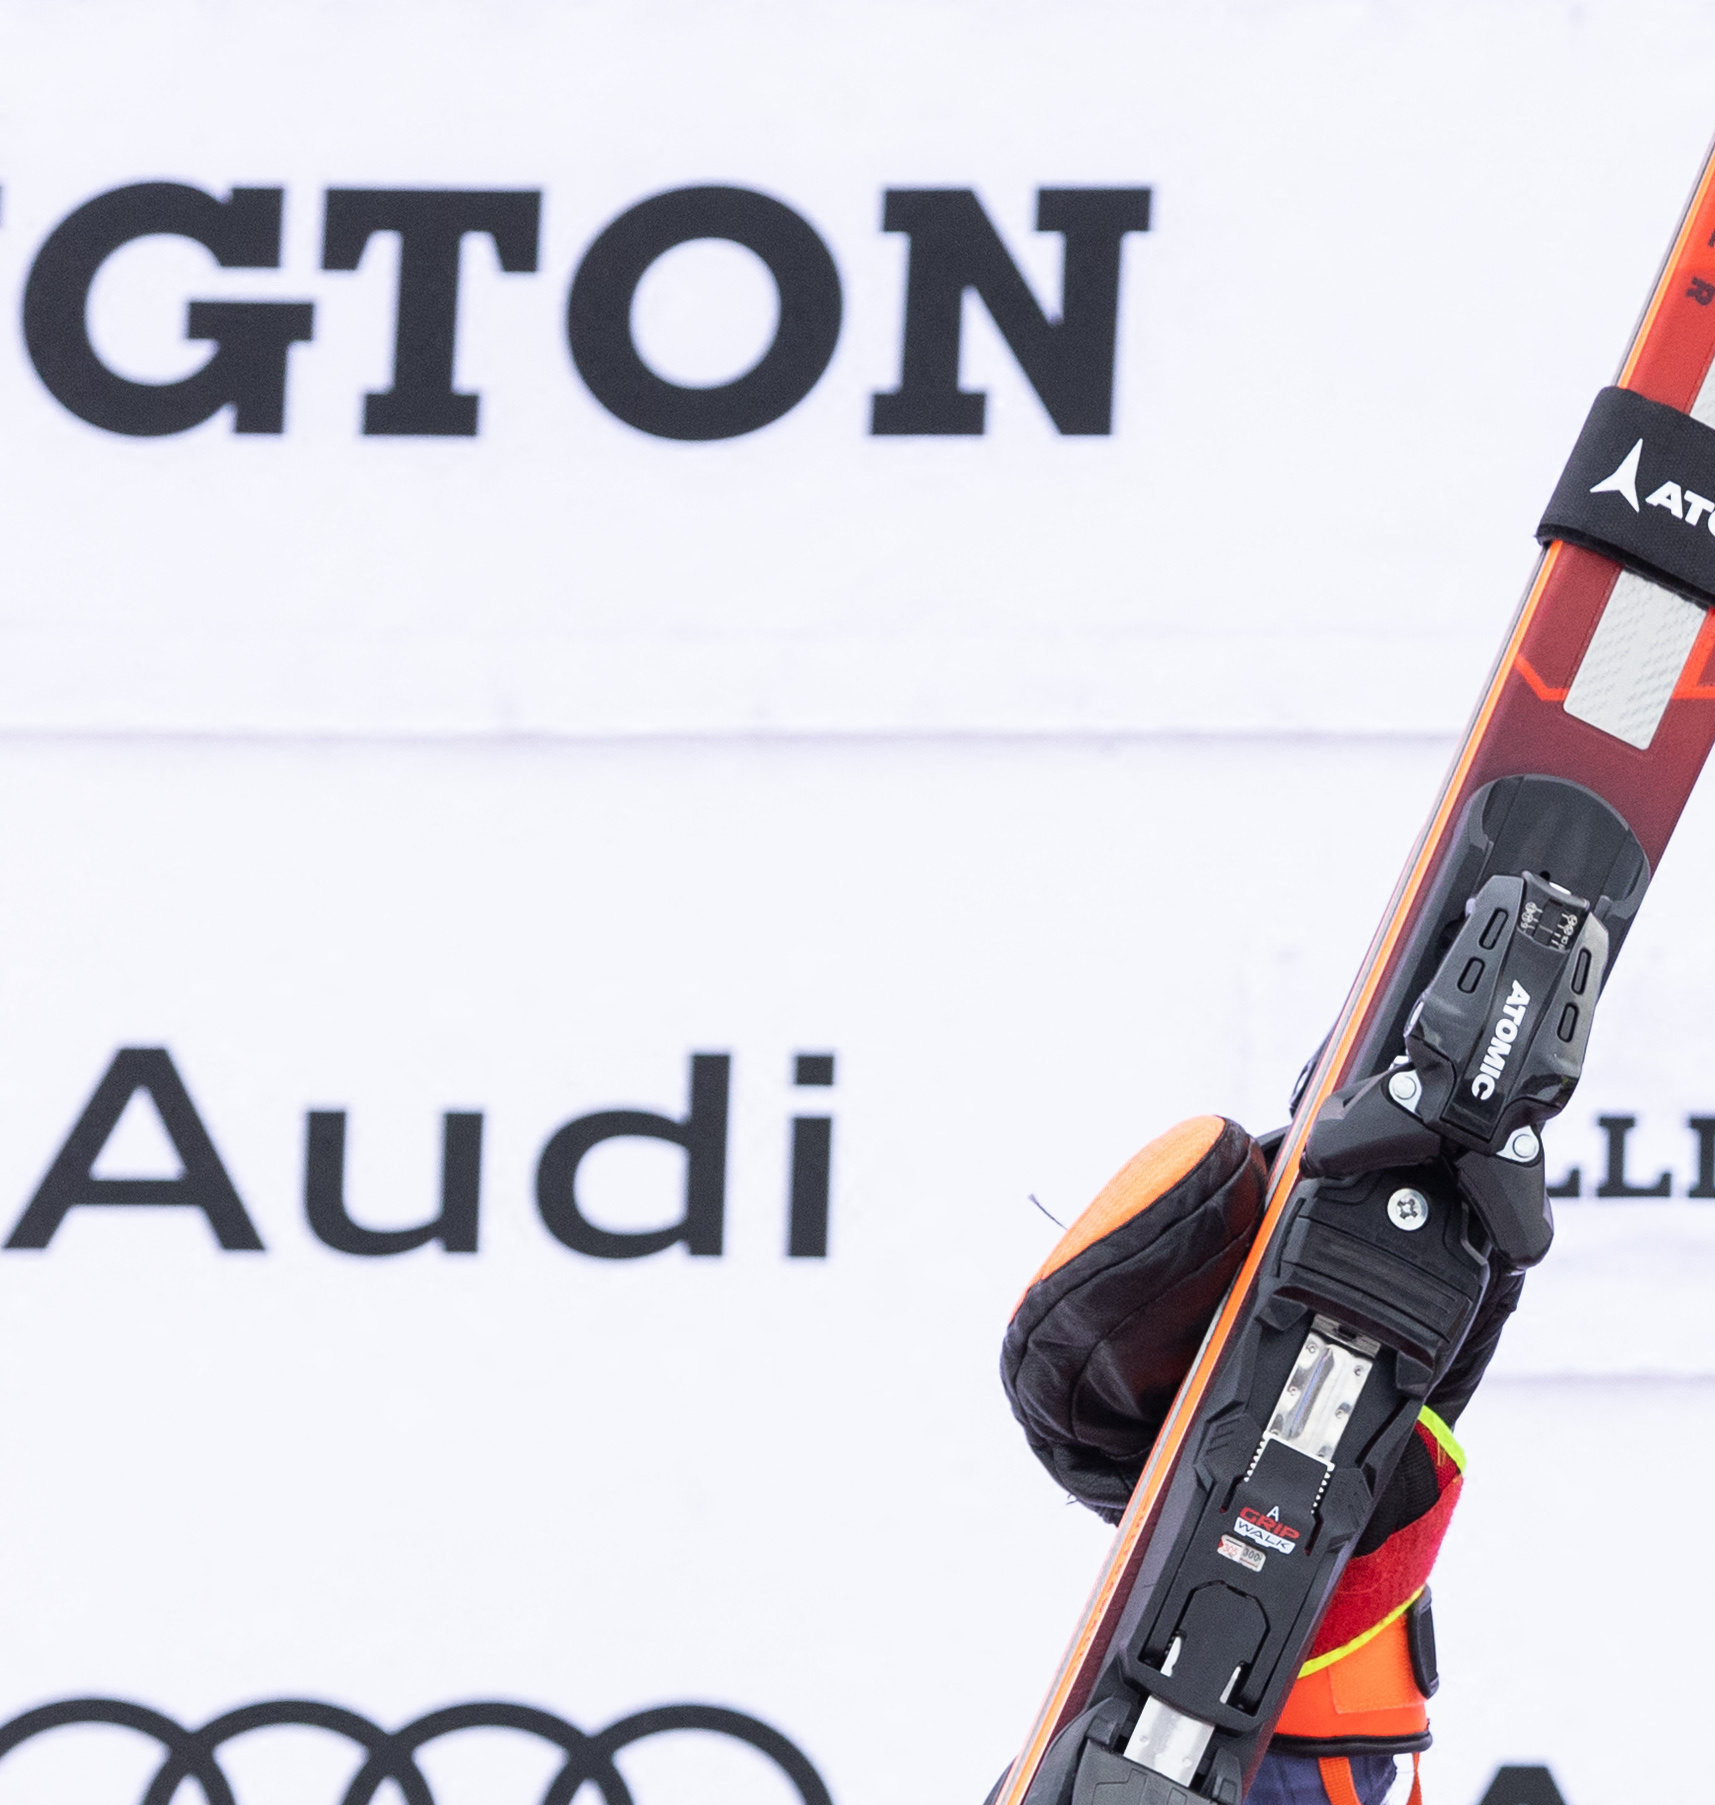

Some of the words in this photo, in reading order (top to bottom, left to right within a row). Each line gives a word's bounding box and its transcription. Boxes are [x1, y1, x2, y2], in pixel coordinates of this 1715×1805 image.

[0, 181, 1153, 441] GTON
[1471, 979, 1531, 1101] ATOMIC
[3, 1046, 835, 1261] Audi
[1238, 1521, 1291, 1551] WALK
[1239, 1506, 1300, 1539] GRIP
